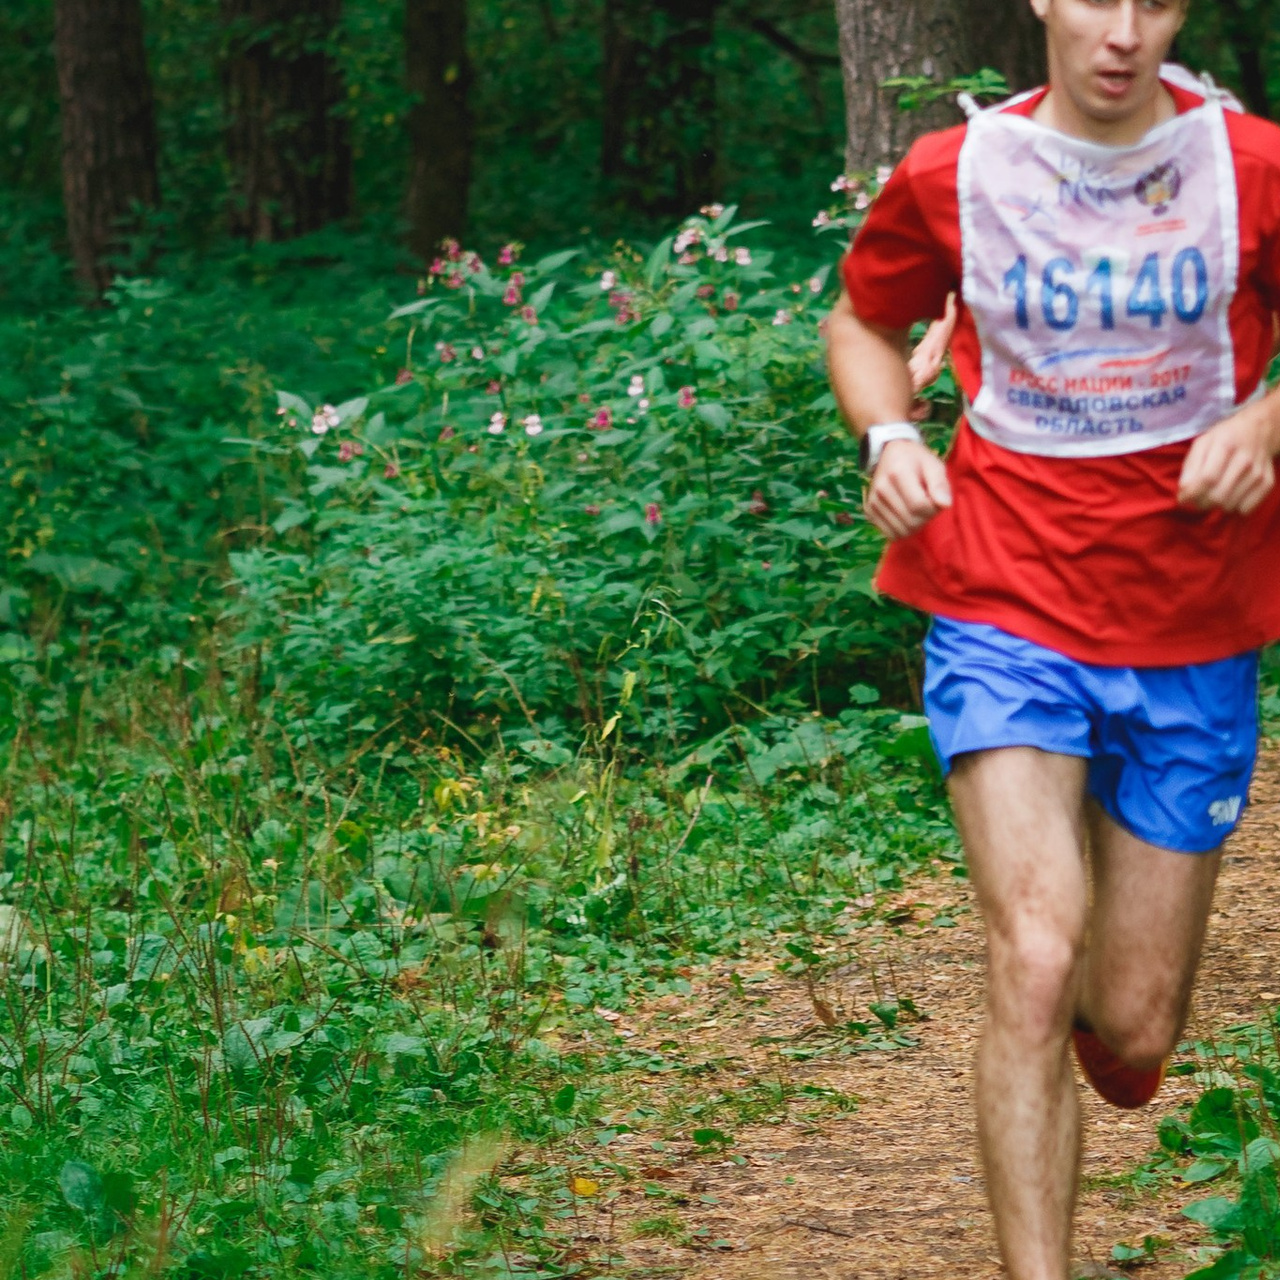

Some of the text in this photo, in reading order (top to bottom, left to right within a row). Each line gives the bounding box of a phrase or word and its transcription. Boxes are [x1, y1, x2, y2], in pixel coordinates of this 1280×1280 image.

[1003, 246, 1208, 331] 16140
[1064, 376, 1132, 395] НАЦИИ
[1007, 385, 1187, 414] СВЕРДЛОВСКАЯ
[1035, 415, 1144, 435] ОБЛАСТЬ
